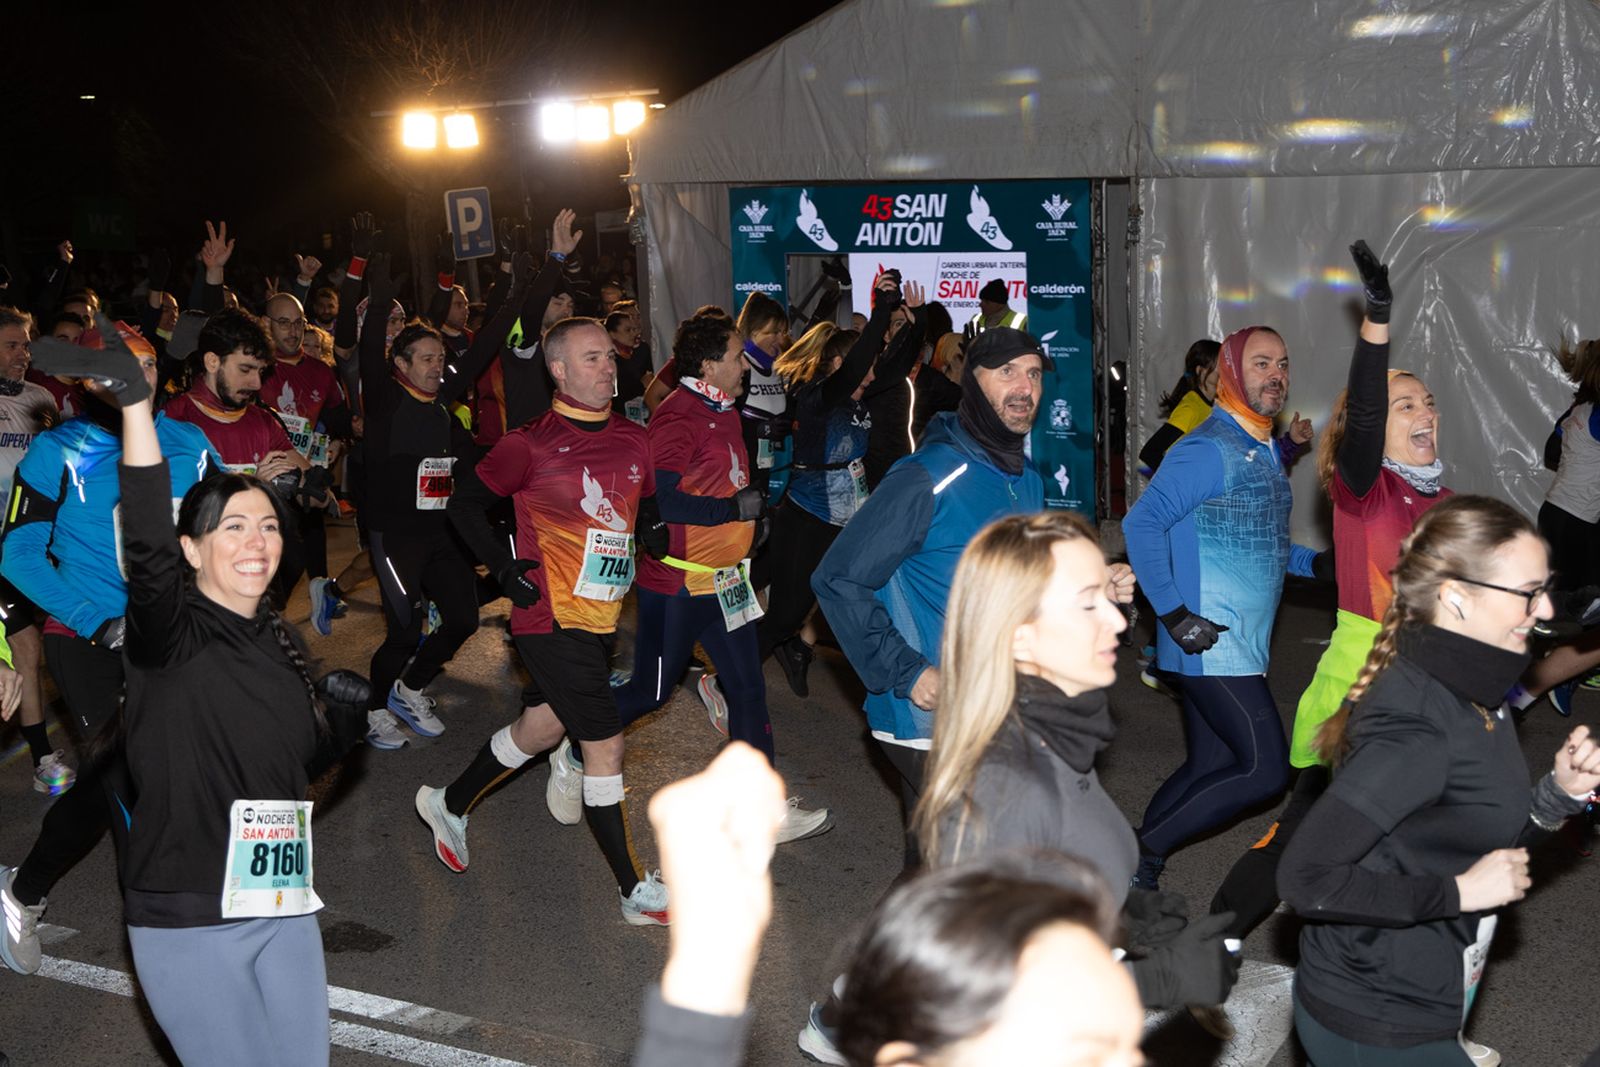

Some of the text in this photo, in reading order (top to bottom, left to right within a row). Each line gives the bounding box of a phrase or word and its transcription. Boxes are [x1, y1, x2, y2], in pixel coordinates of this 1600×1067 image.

[88, 213, 122, 235] WC
[455, 197, 483, 250] P
[808, 223, 825, 242] 43
[855, 215, 943, 246] ANTÓN
[979, 222, 997, 240] 43
[940, 271, 980, 279] NOCHE DE
[735, 282, 782, 291] calderón
[937, 281, 979, 299] SAN
[1030, 284, 1085, 294] calderón
[596, 504, 614, 523] 43
[599, 556, 629, 579] 7744
[257, 813, 295, 825] NOCHE DE
[242, 827, 264, 840] SAN
[250, 842, 304, 877] 8160
[272, 879, 290, 887] ELENA
